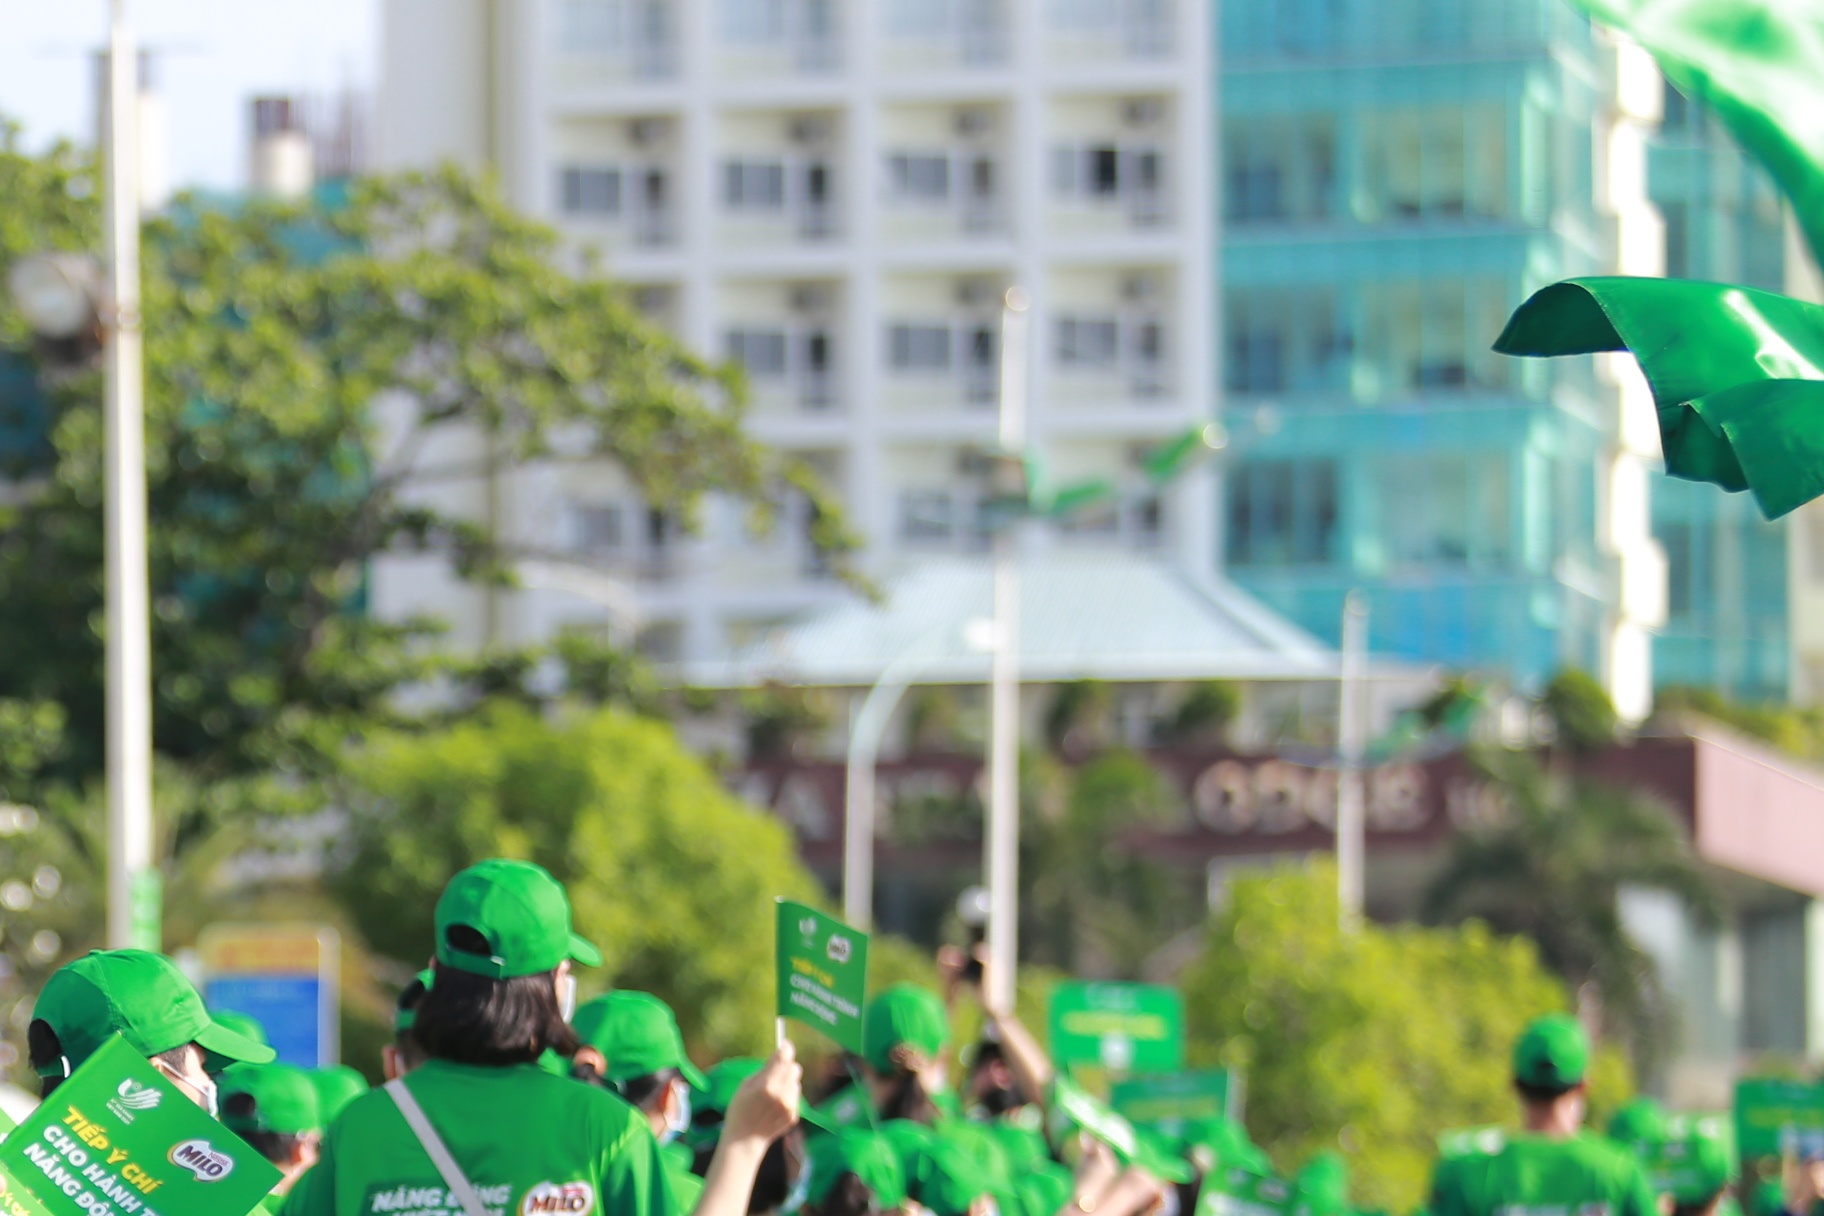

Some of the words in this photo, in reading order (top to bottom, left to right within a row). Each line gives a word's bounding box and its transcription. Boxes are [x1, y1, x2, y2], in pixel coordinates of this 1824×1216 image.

[23, 1143, 81, 1197] NĂNG
[43, 1125, 86, 1167] CHO
[82, 1163, 142, 1213] HÀNH
[62, 1105, 108, 1151] TIẾP
[106, 1147, 127, 1164] Ý
[121, 1162, 164, 1194] CHÍ
[176, 1145, 223, 1177] MILO
[529, 1195, 586, 1214] MILO
